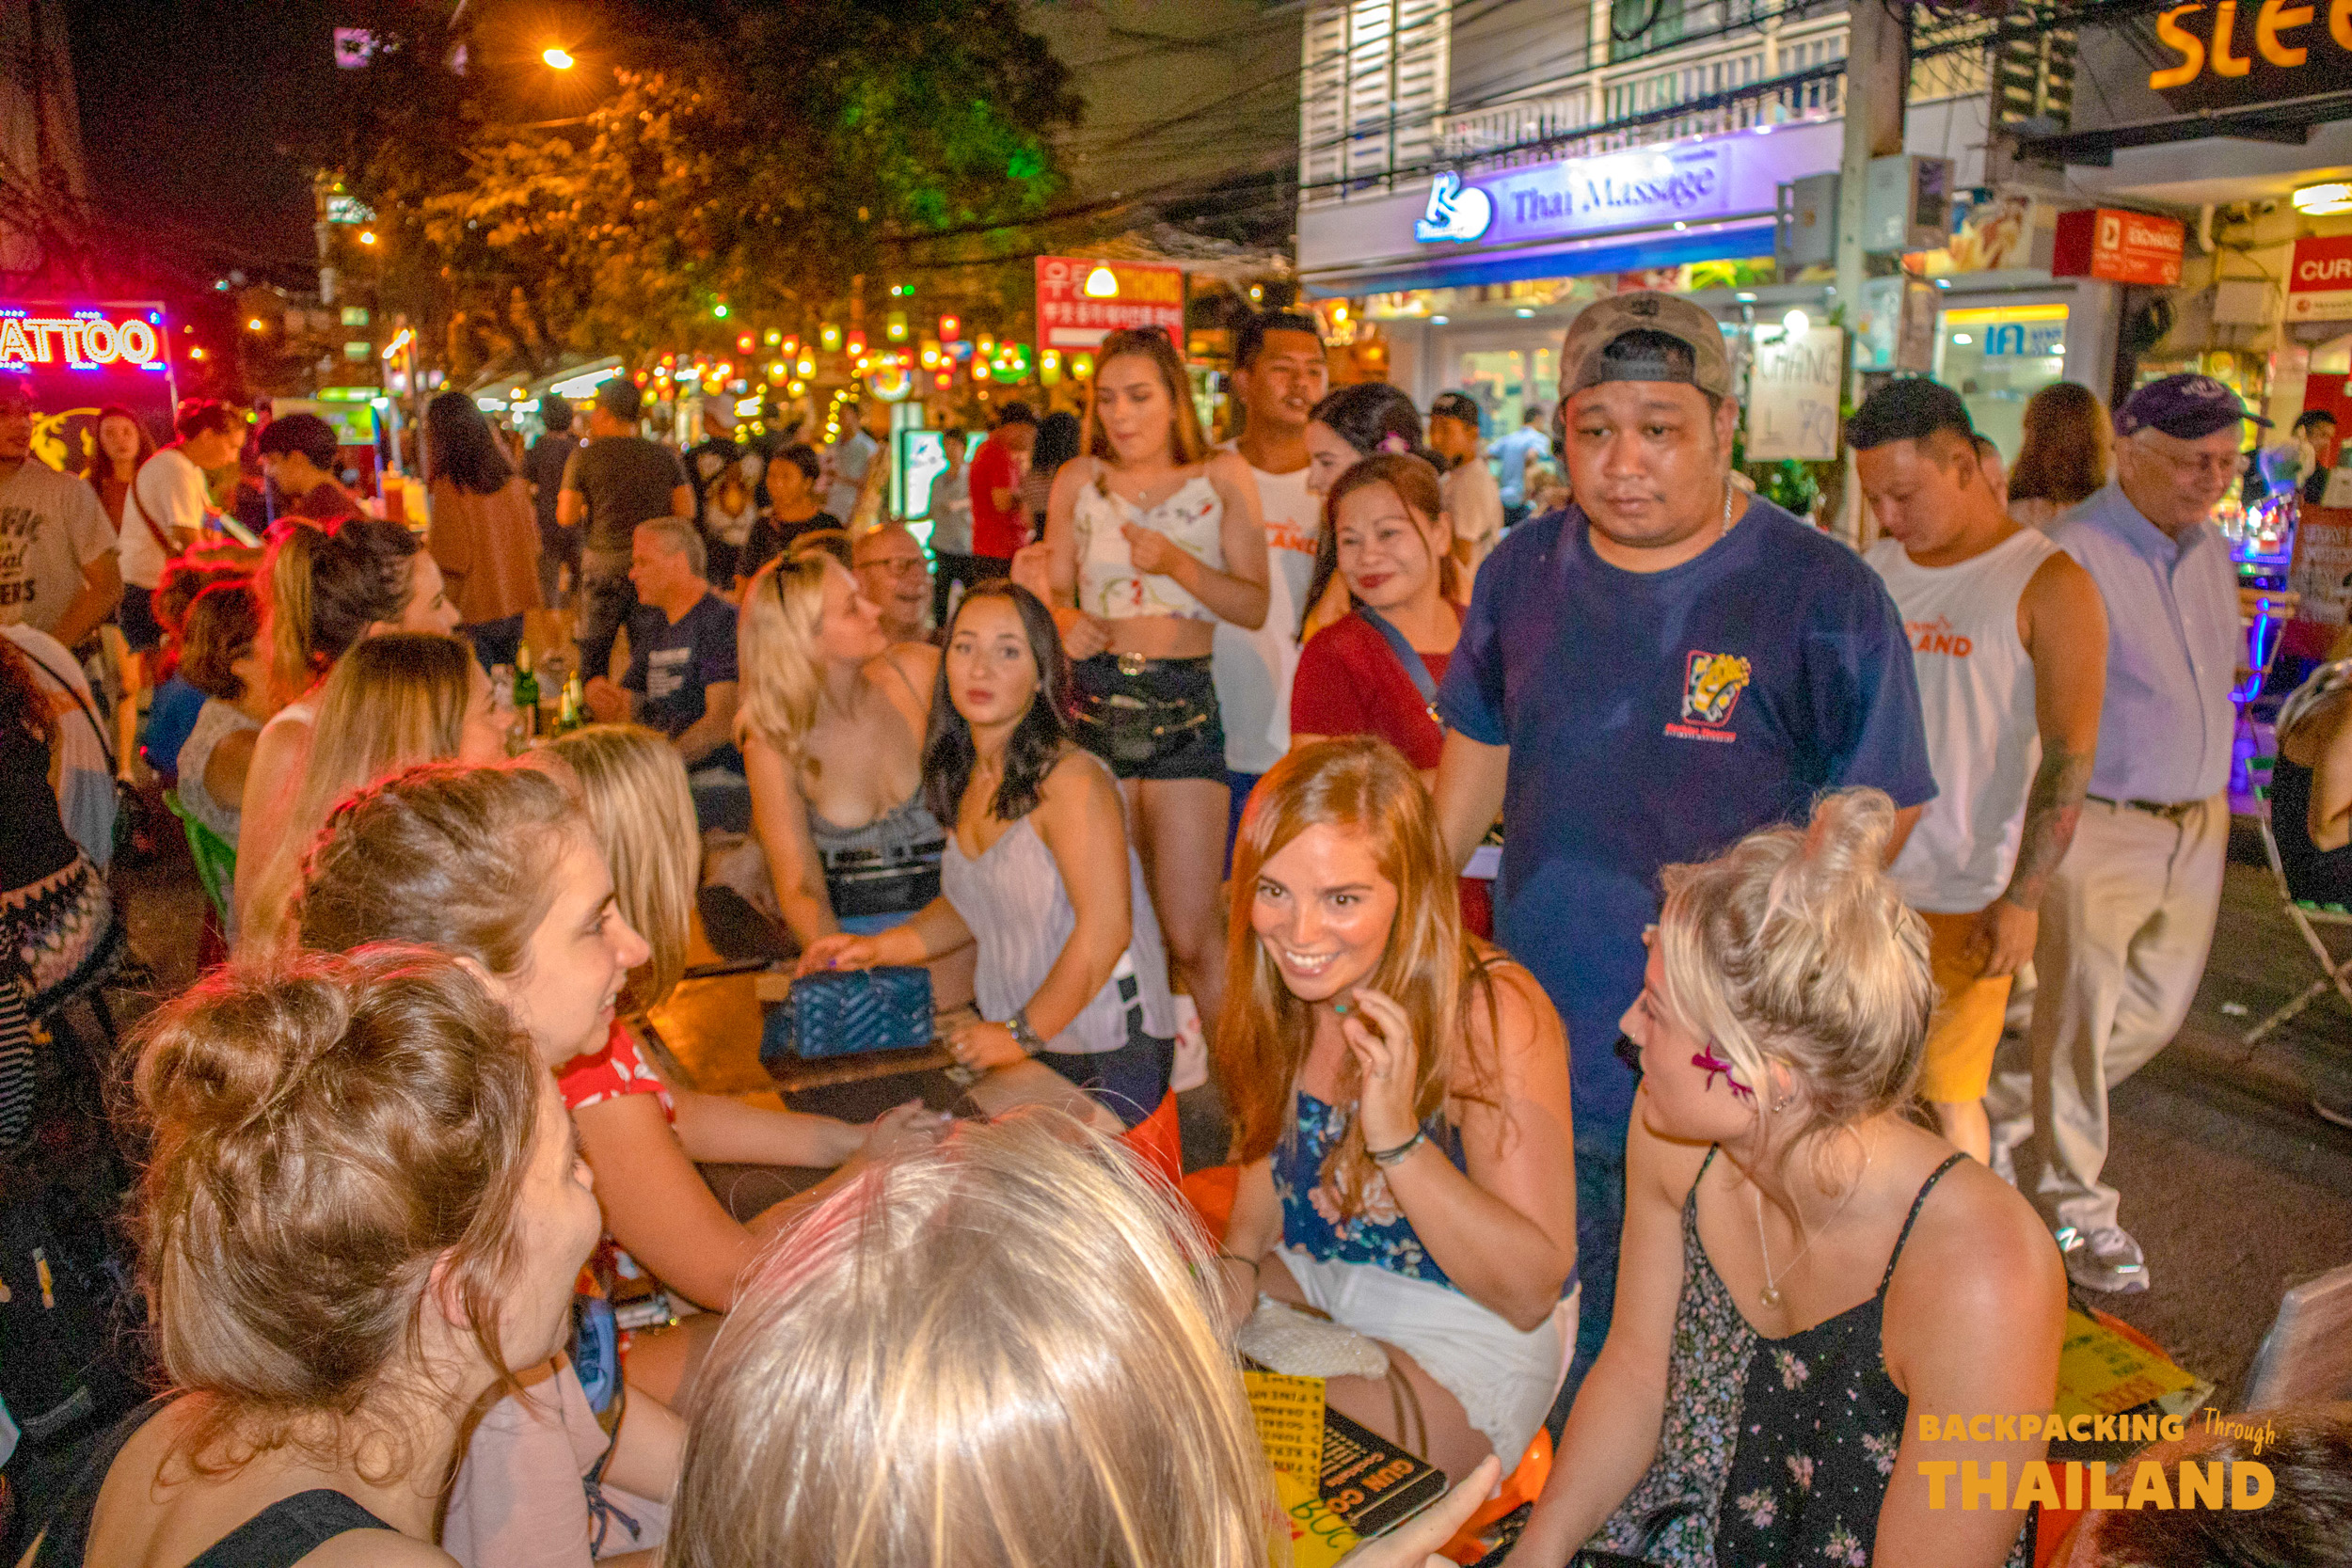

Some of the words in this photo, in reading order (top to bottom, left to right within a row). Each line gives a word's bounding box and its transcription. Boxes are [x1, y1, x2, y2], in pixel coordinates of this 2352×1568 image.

[1512, 187, 1573, 224] Thai
[0, 318, 157, 365] ATTOO
[1361, 1459, 1414, 1493] GUN
